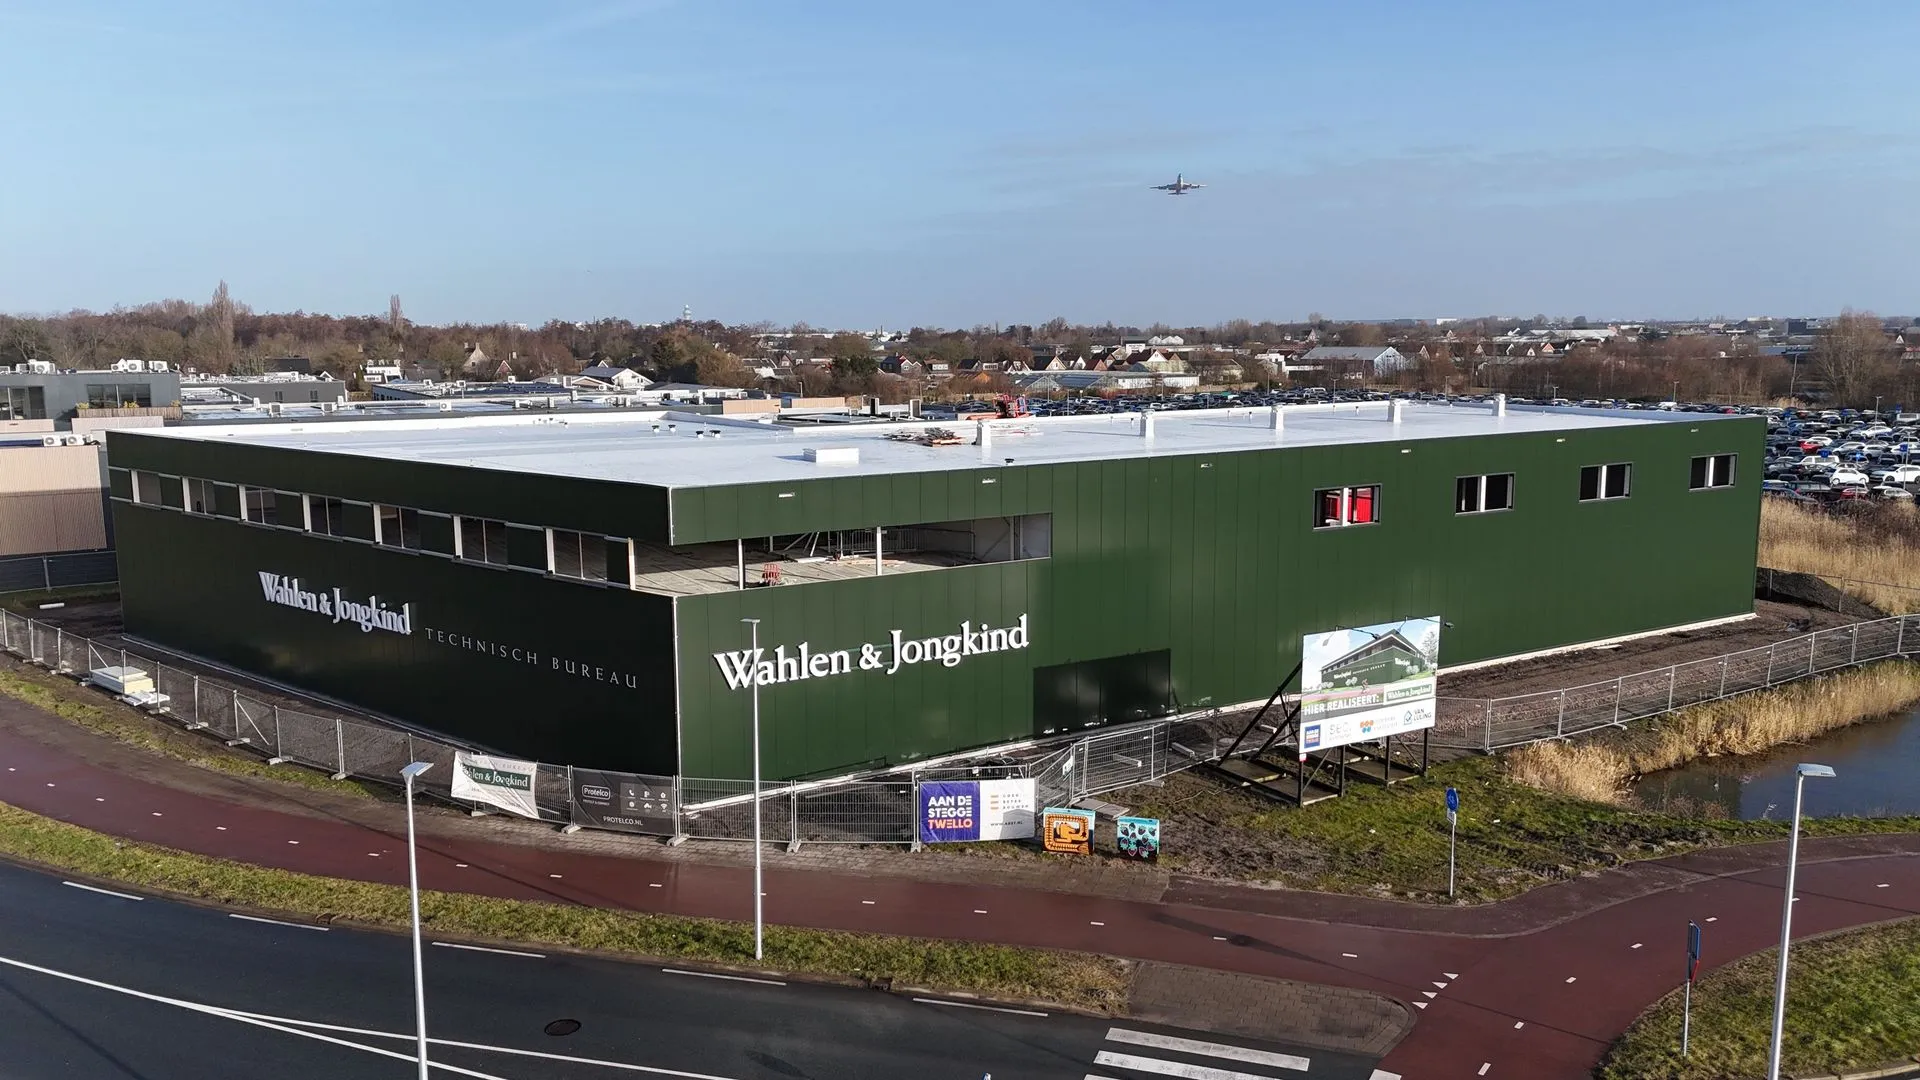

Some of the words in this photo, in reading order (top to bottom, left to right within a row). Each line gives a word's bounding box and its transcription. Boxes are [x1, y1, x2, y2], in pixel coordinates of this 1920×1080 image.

[258, 571, 318, 612] Wahlen
[318, 597, 333, 616] &
[332, 587, 412, 635] Jongkind
[712, 641, 851, 691] Wahlen
[858, 643, 883, 670] &
[887, 613, 1030, 675] Jongkind
[425, 627, 538, 666] TECHNISCH
[552, 656, 639, 690] BUREAU
[1304, 703, 1326, 716] HIER
[1326, 693, 1380, 711] REALISEERT:
[484, 773, 491, 782] &
[583, 787, 609, 798] Protelco
[928, 795, 955, 807] AAN
[957, 795, 972, 807] DE
[928, 806, 972, 819] STEGGE
[602, 815, 644, 827] PROTELCO.NL
[928, 818, 972, 830] TWELLO
